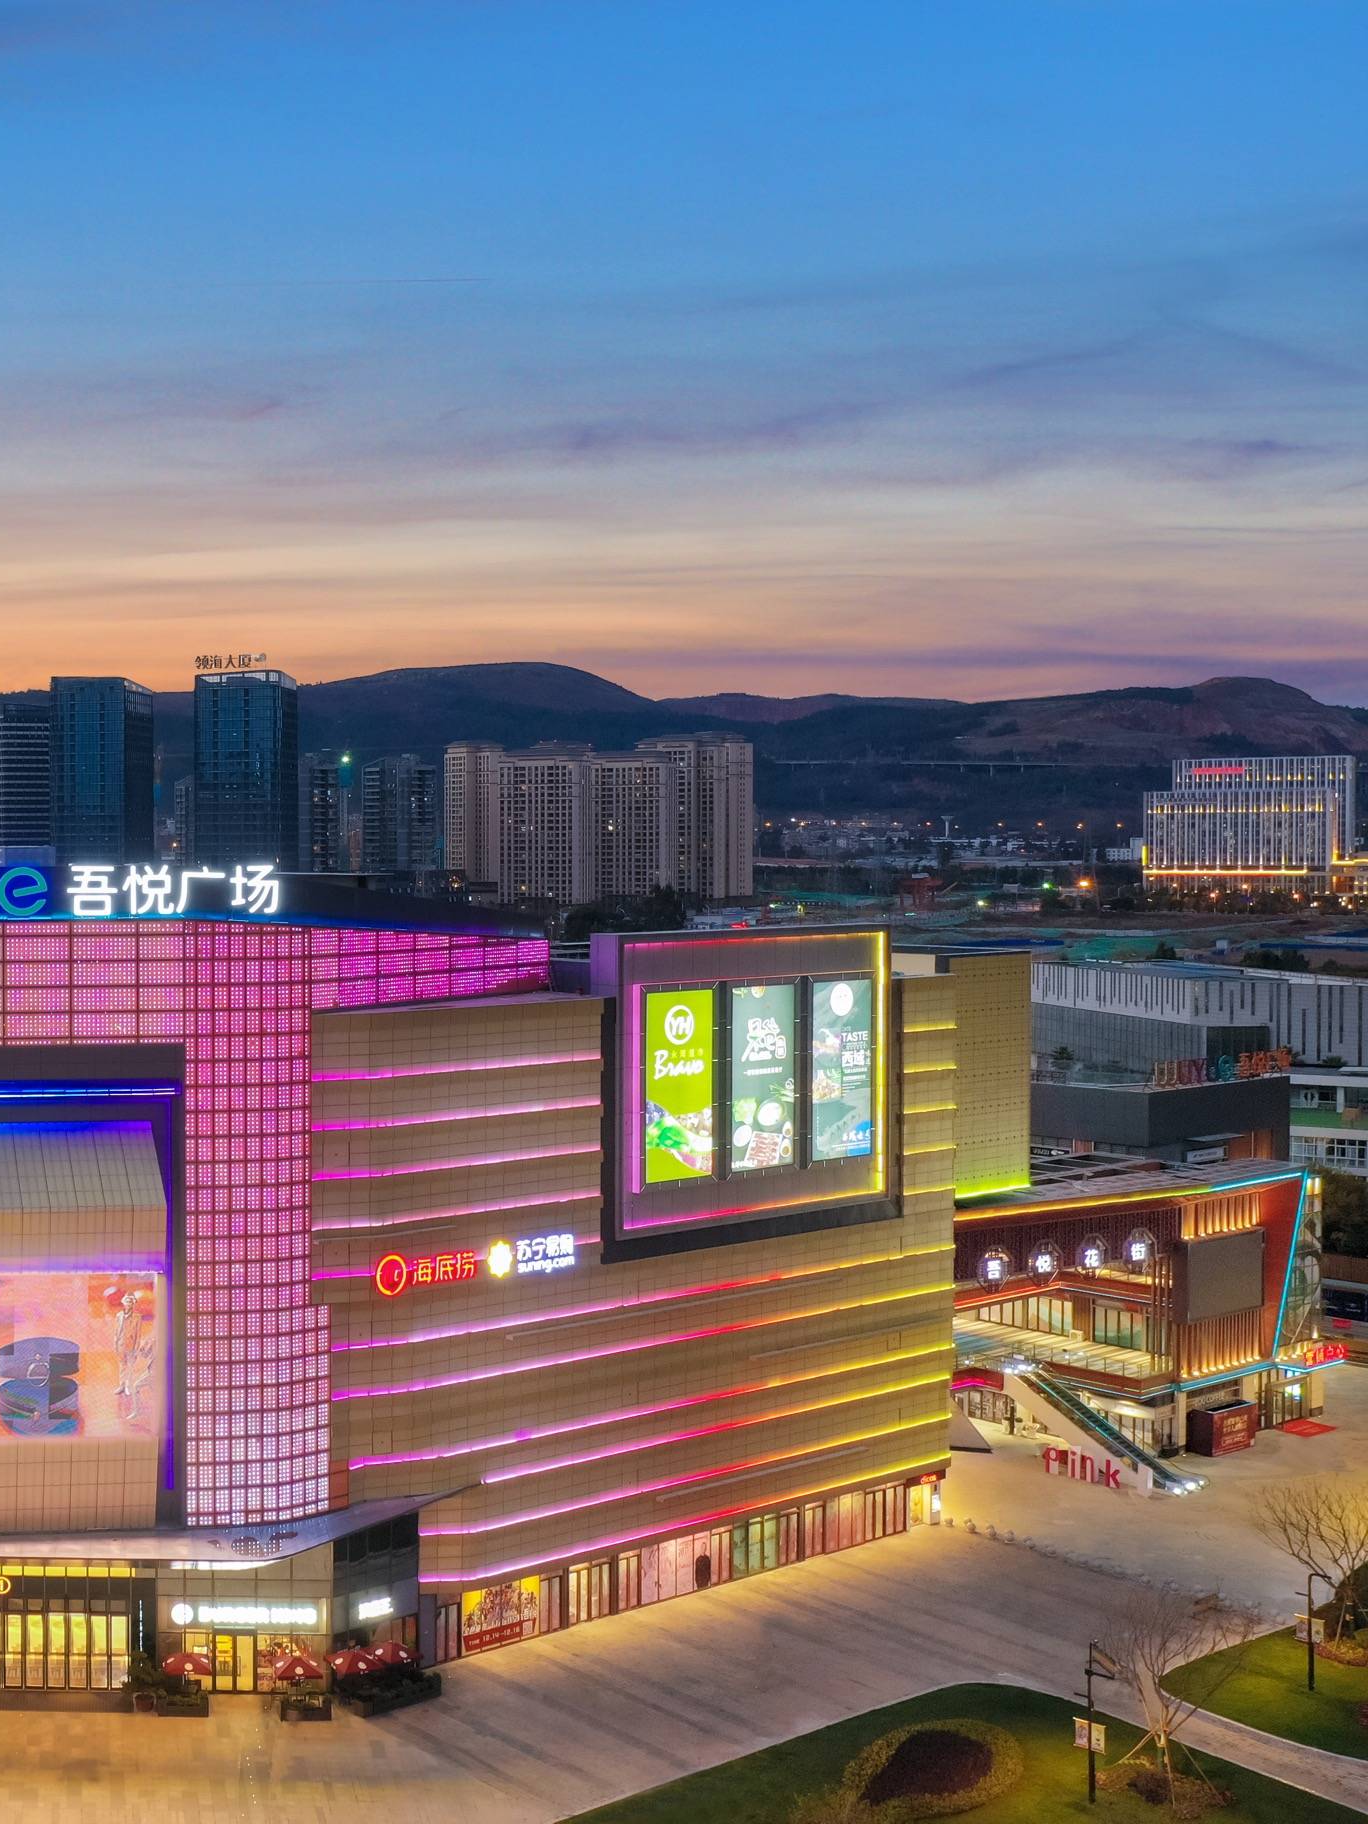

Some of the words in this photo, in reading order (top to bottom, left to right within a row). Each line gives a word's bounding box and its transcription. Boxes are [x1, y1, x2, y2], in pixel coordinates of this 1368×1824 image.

[66, 864, 280, 917] 吾悦广场
[841, 1031, 869, 1042] TASTE
[654, 1049, 705, 1081] Bravo
[516, 1234, 574, 1261] 苏宁易购
[986, 1242, 1146, 1281] 吾悦花街
[412, 1251, 475, 1286] 海底捞
[517, 1254, 575, 1274] suning.com
